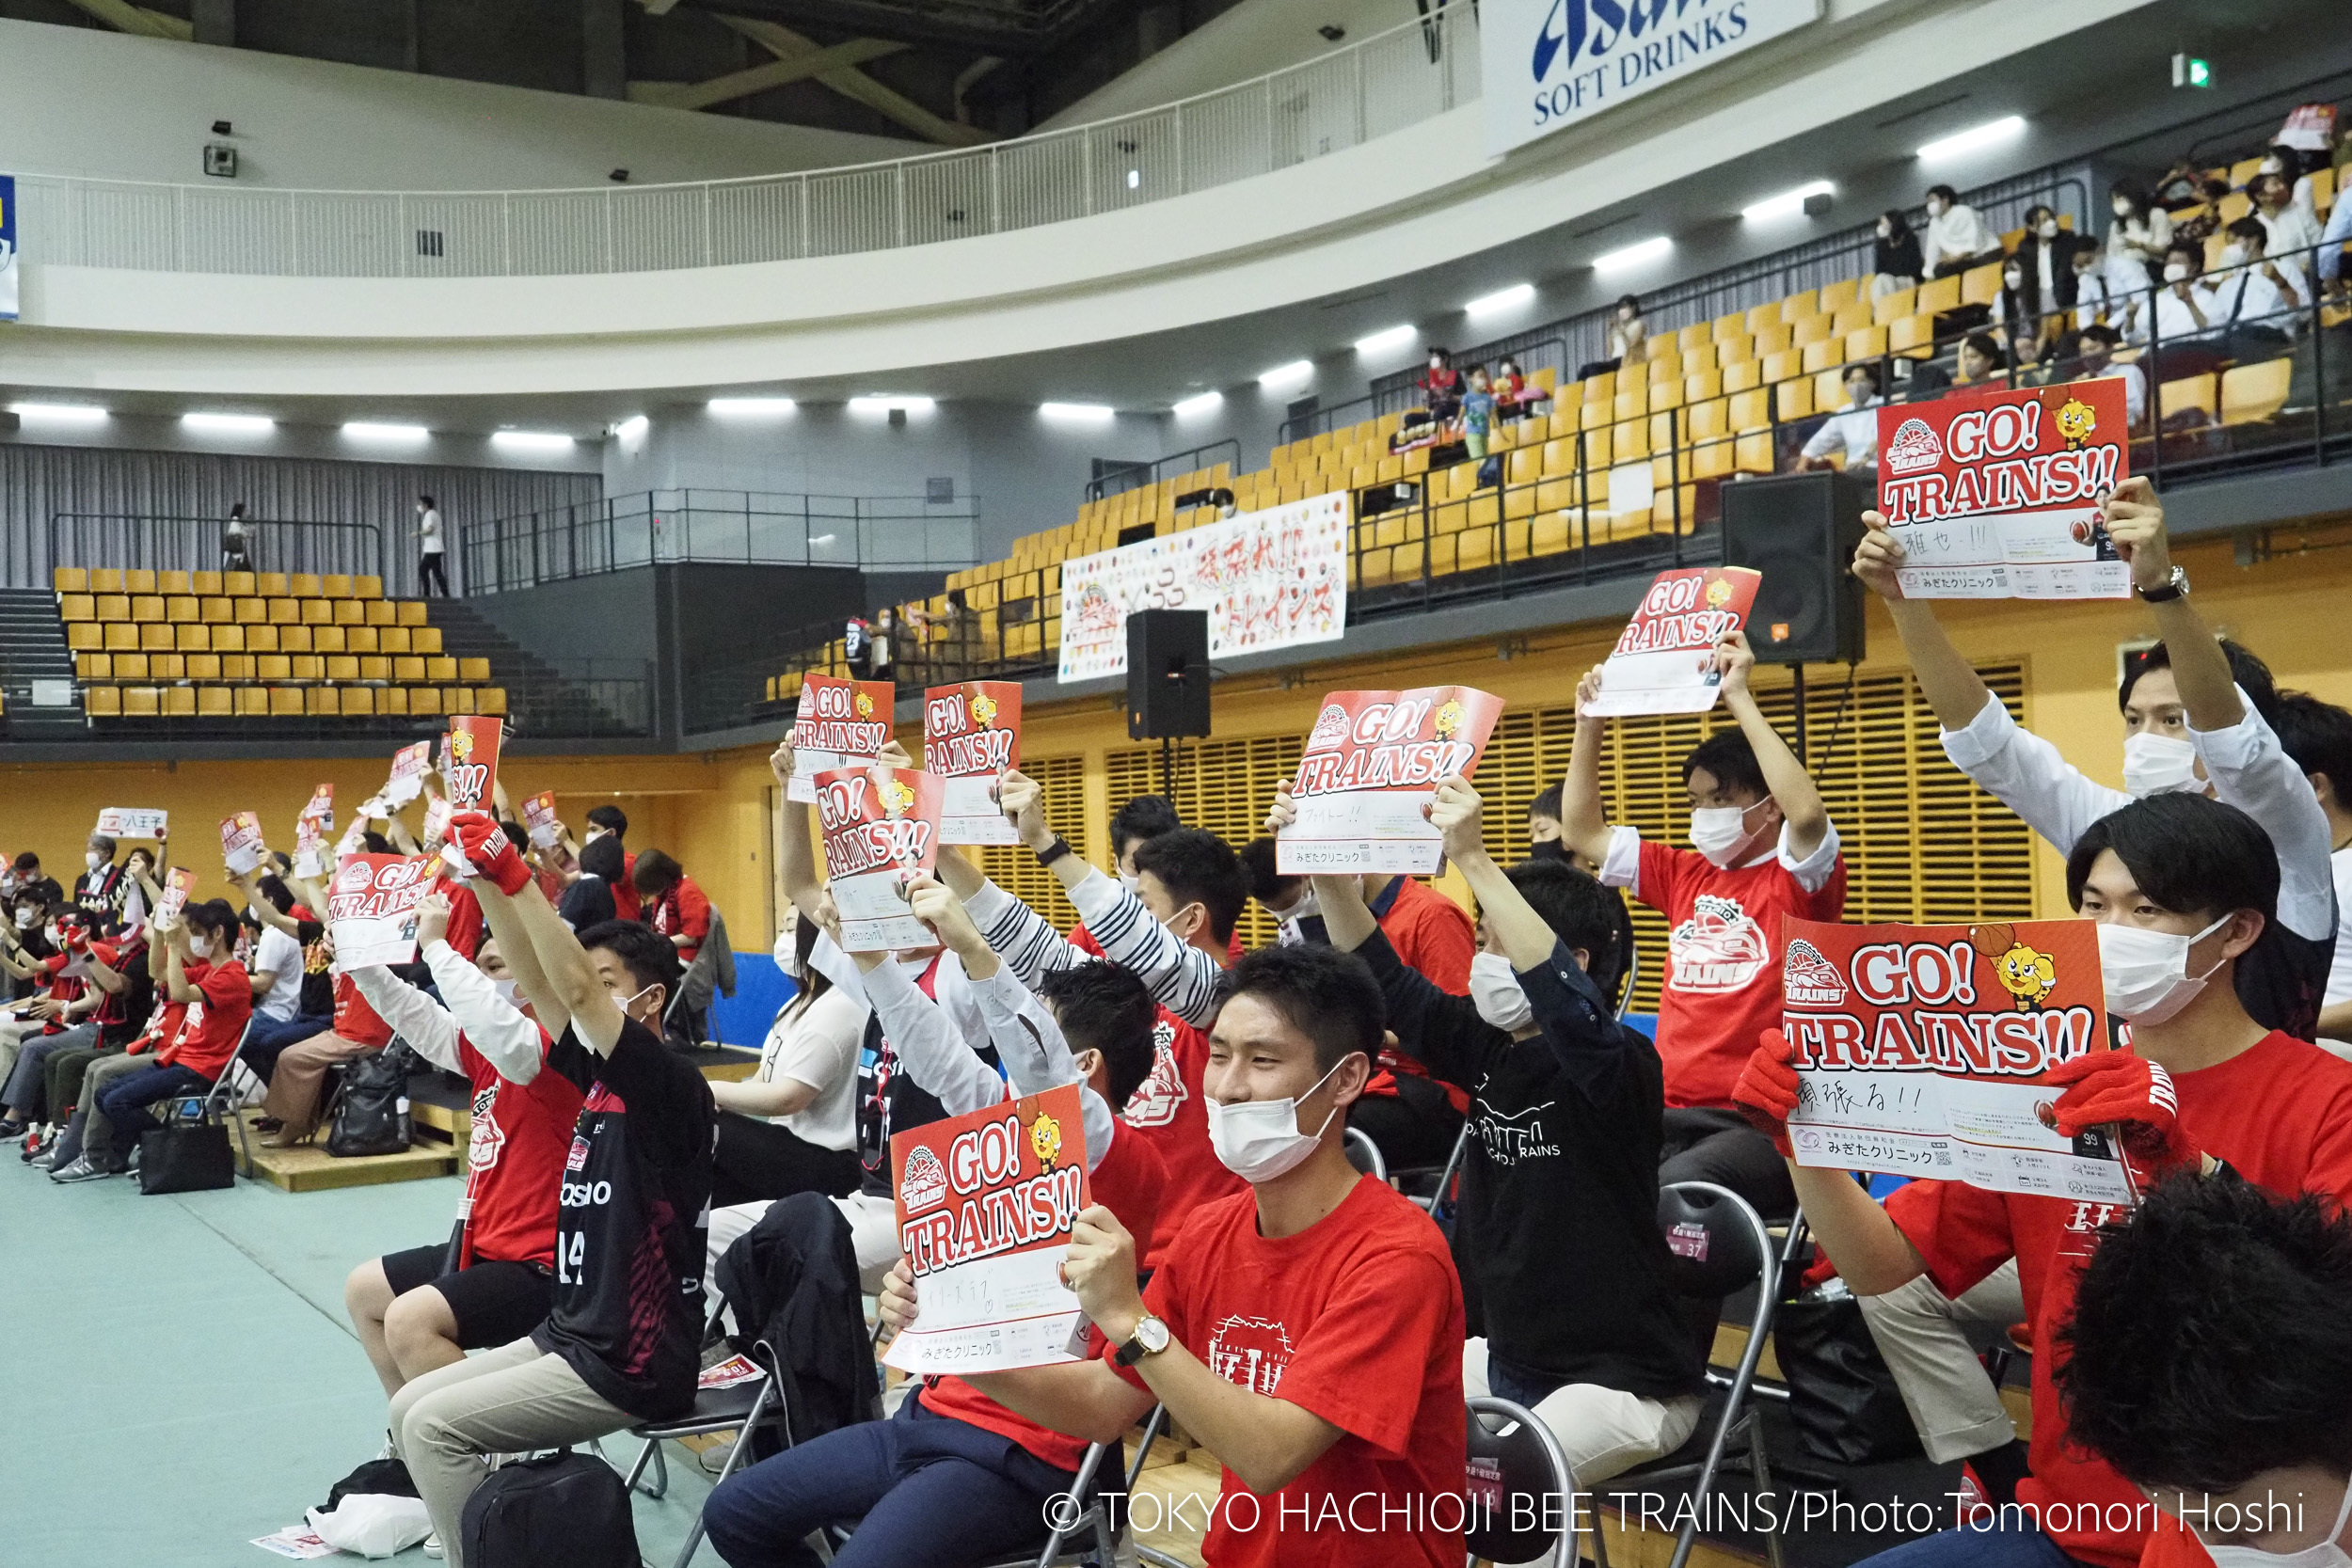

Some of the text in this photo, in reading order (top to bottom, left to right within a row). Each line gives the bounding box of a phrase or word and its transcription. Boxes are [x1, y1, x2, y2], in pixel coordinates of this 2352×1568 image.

[1534, 2, 1748, 126] SOFT DRINKS
[1947, 401, 2042, 463] GO!
[1884, 445, 2120, 527] TRAINS!!
[1645, 576, 1702, 615] GO!
[1923, 578, 1994, 588] みぎたクリニック
[817, 686, 851, 718] GO!
[927, 692, 967, 736] GO!
[1352, 698, 1432, 744] GO!
[1291, 741, 1475, 798] TRAINS!!
[817, 775, 866, 830] GO!
[1296, 852, 1359, 863] みぎたクリニック
[1850, 942, 1974, 1006] GO!
[1786, 1007, 2093, 1075] TRAINS!!
[949, 1116, 1021, 1195] GO!
[1828, 1141, 1932, 1164] みぎたクリニック
[2083, 1132, 2098, 1146] 99
[902, 1164, 1082, 1277] TRAINS!!
[559, 1231, 585, 1285] 14
[1687, 1243, 1701, 1258] 37
[922, 1342, 992, 1360] みぎたクリニック
